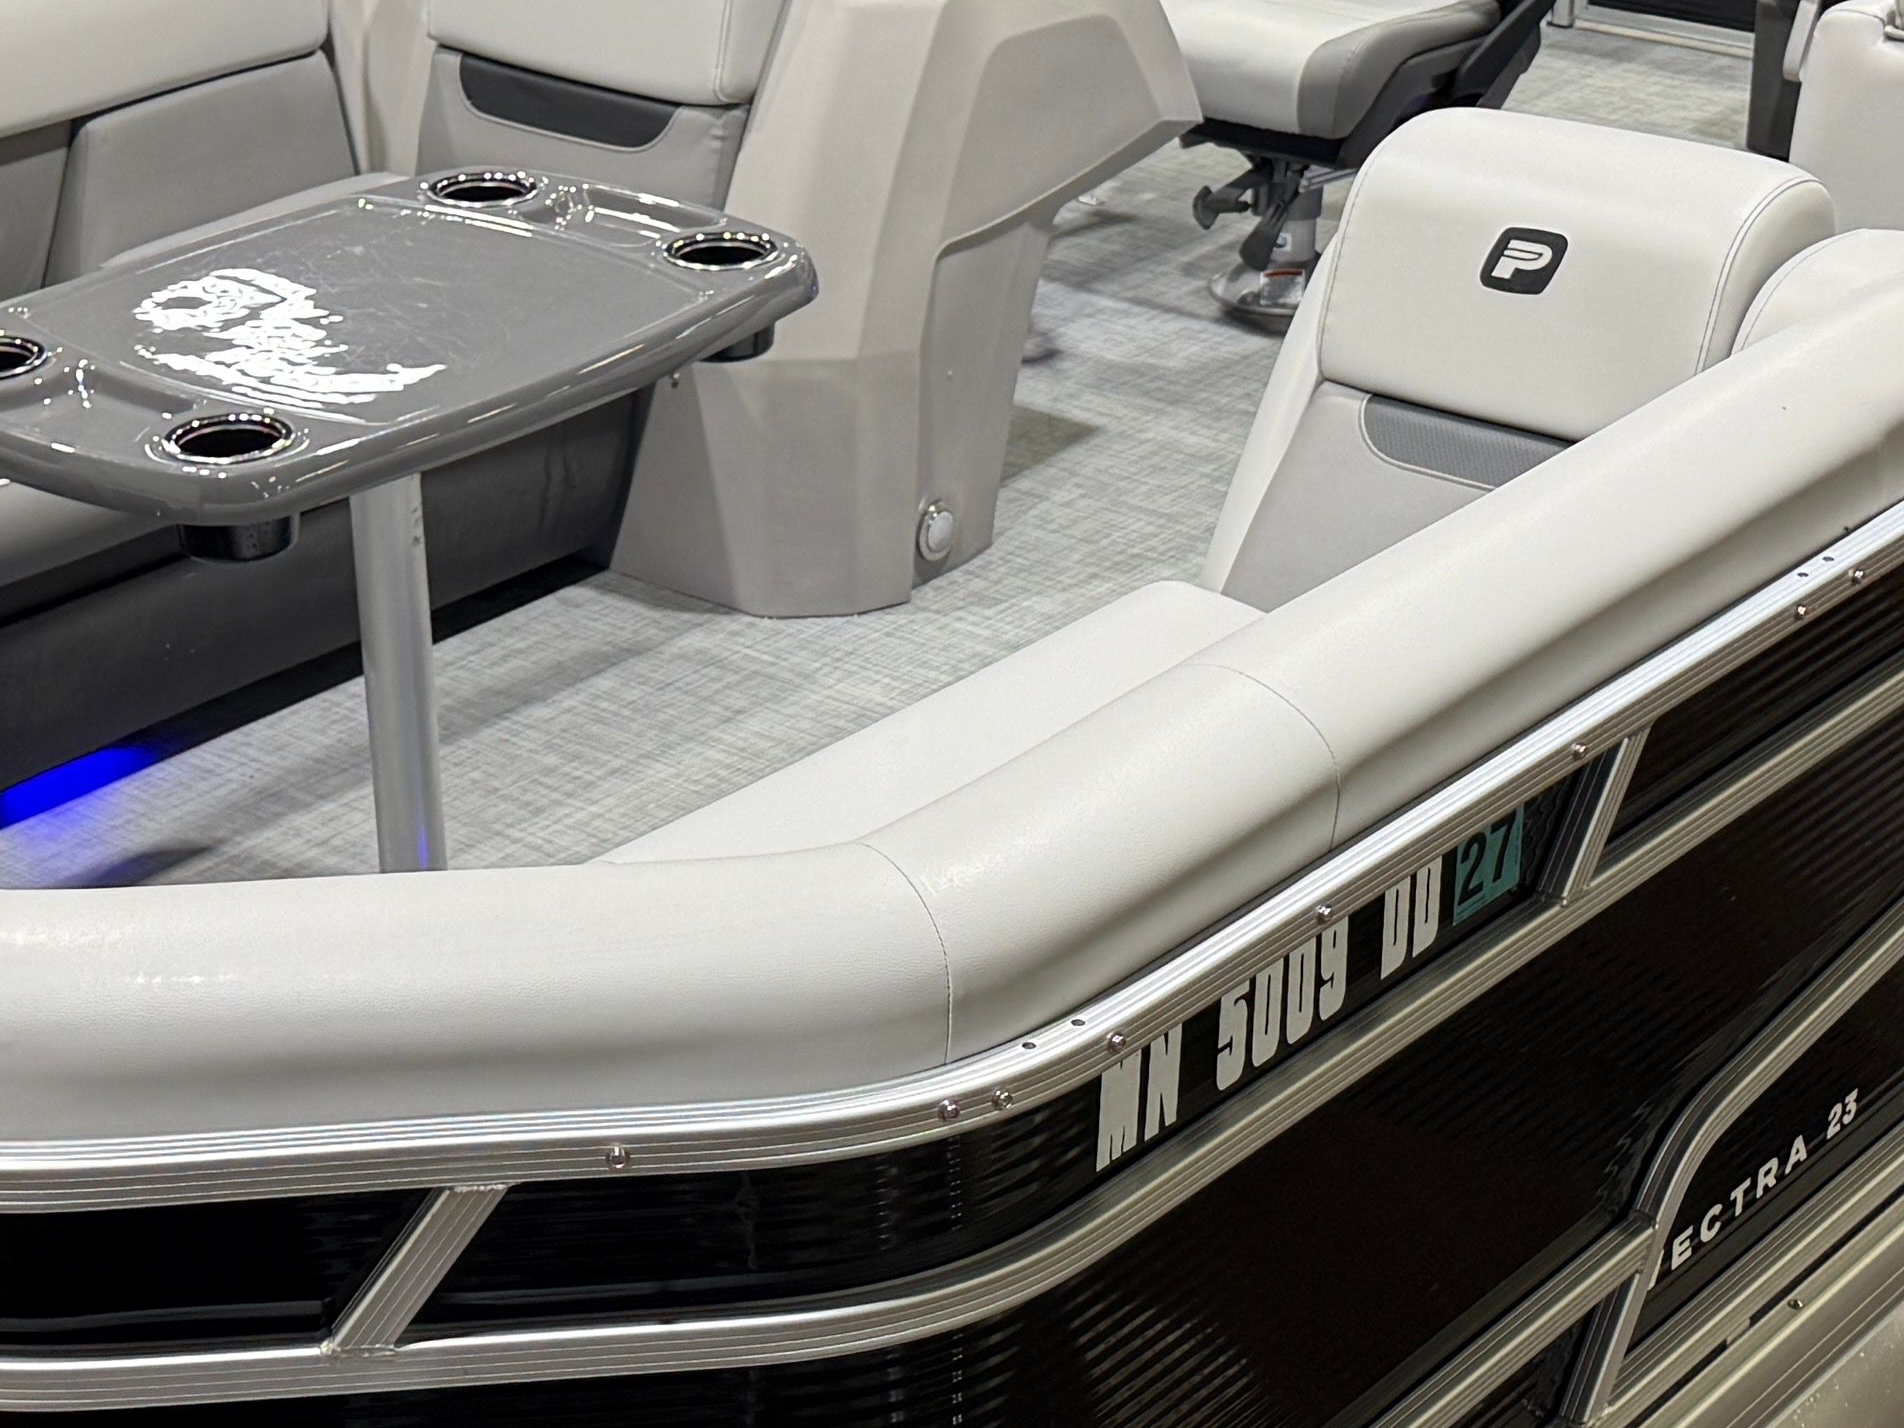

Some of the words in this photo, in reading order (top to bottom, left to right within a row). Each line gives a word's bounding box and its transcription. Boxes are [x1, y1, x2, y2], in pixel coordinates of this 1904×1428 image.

[1457, 808, 1517, 906] 27
[1096, 1023, 1183, 1172] MN
[1216, 915, 1349, 1091] 5009
[1827, 1088, 1859, 1140] 23
